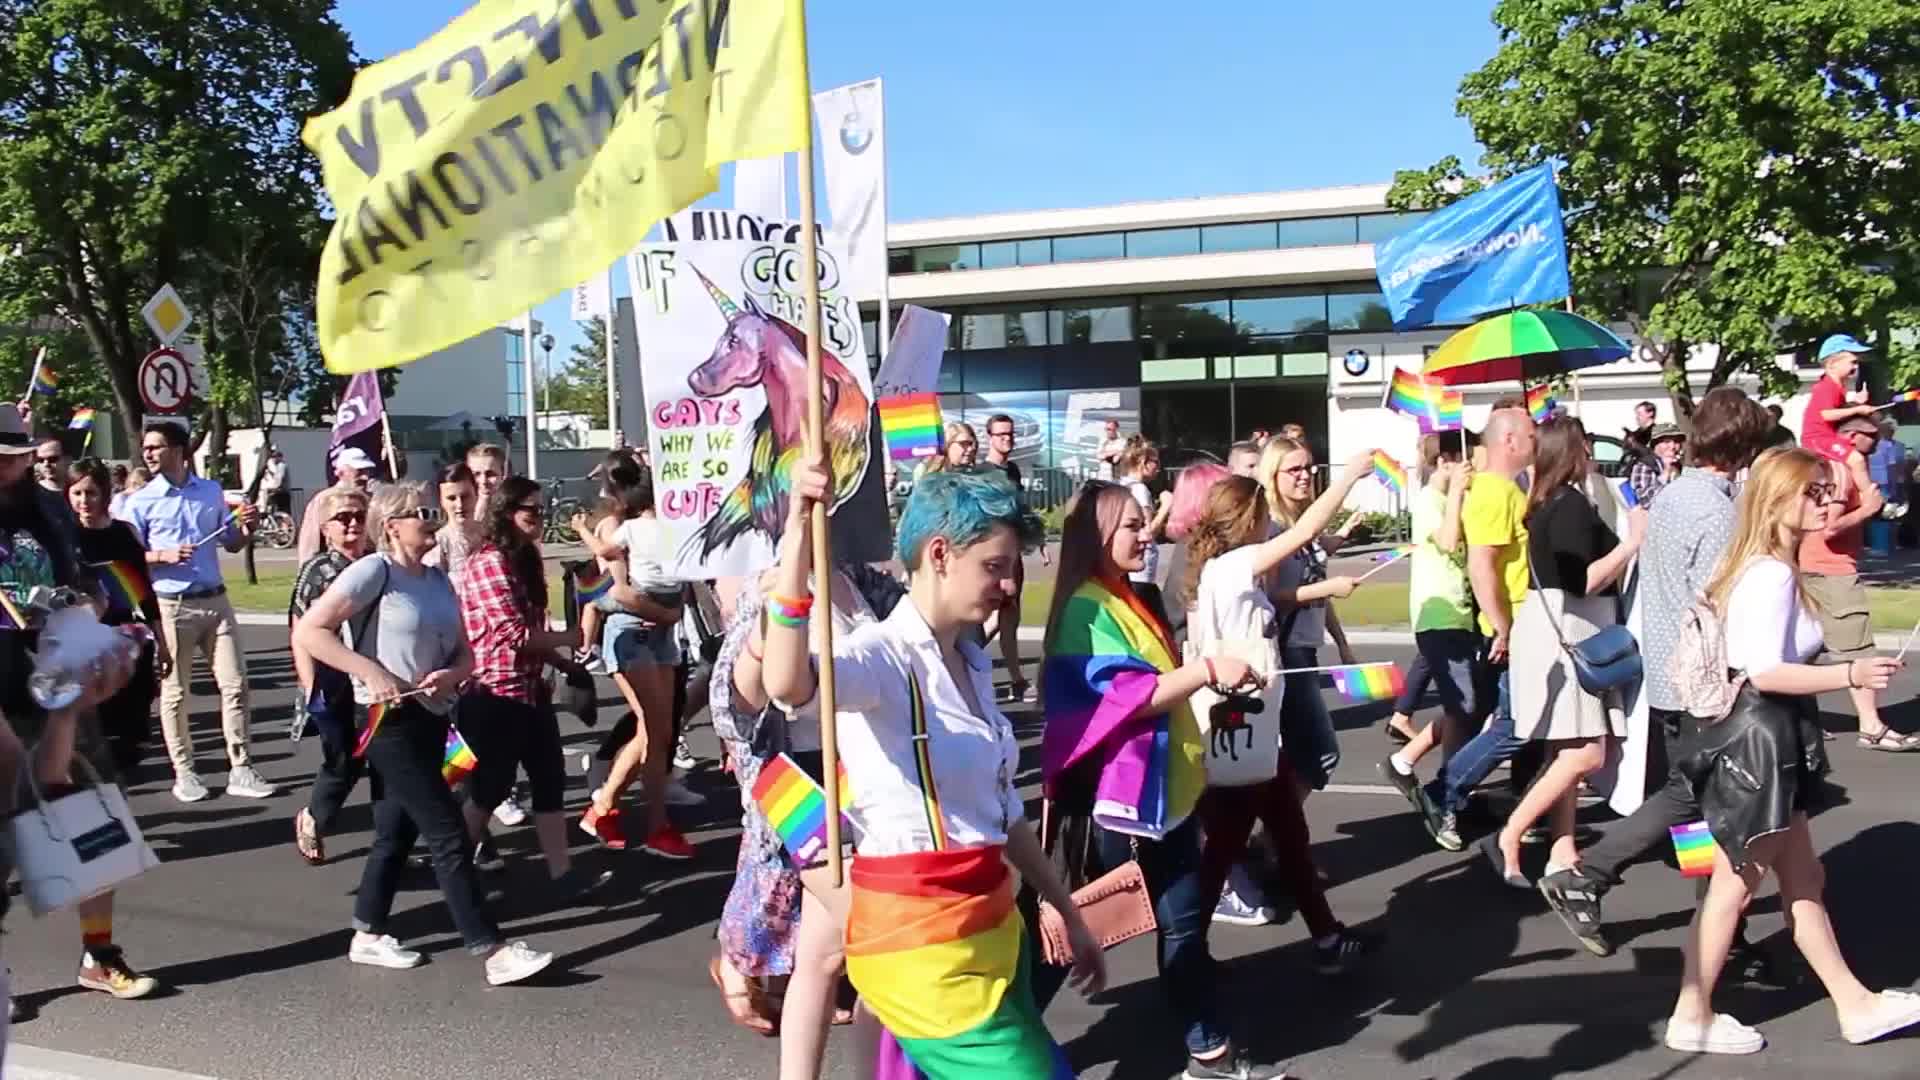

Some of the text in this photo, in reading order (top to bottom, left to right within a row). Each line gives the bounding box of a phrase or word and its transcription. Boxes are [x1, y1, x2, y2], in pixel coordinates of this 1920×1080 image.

[636, 250, 676, 314] IF
[771, 293, 858, 358] HAES
[654, 397, 742, 429] GAYS
[660, 428, 735, 453] WHY WE
[662, 459, 729, 481] ARE SO
[662, 482, 723, 524] CUTE
